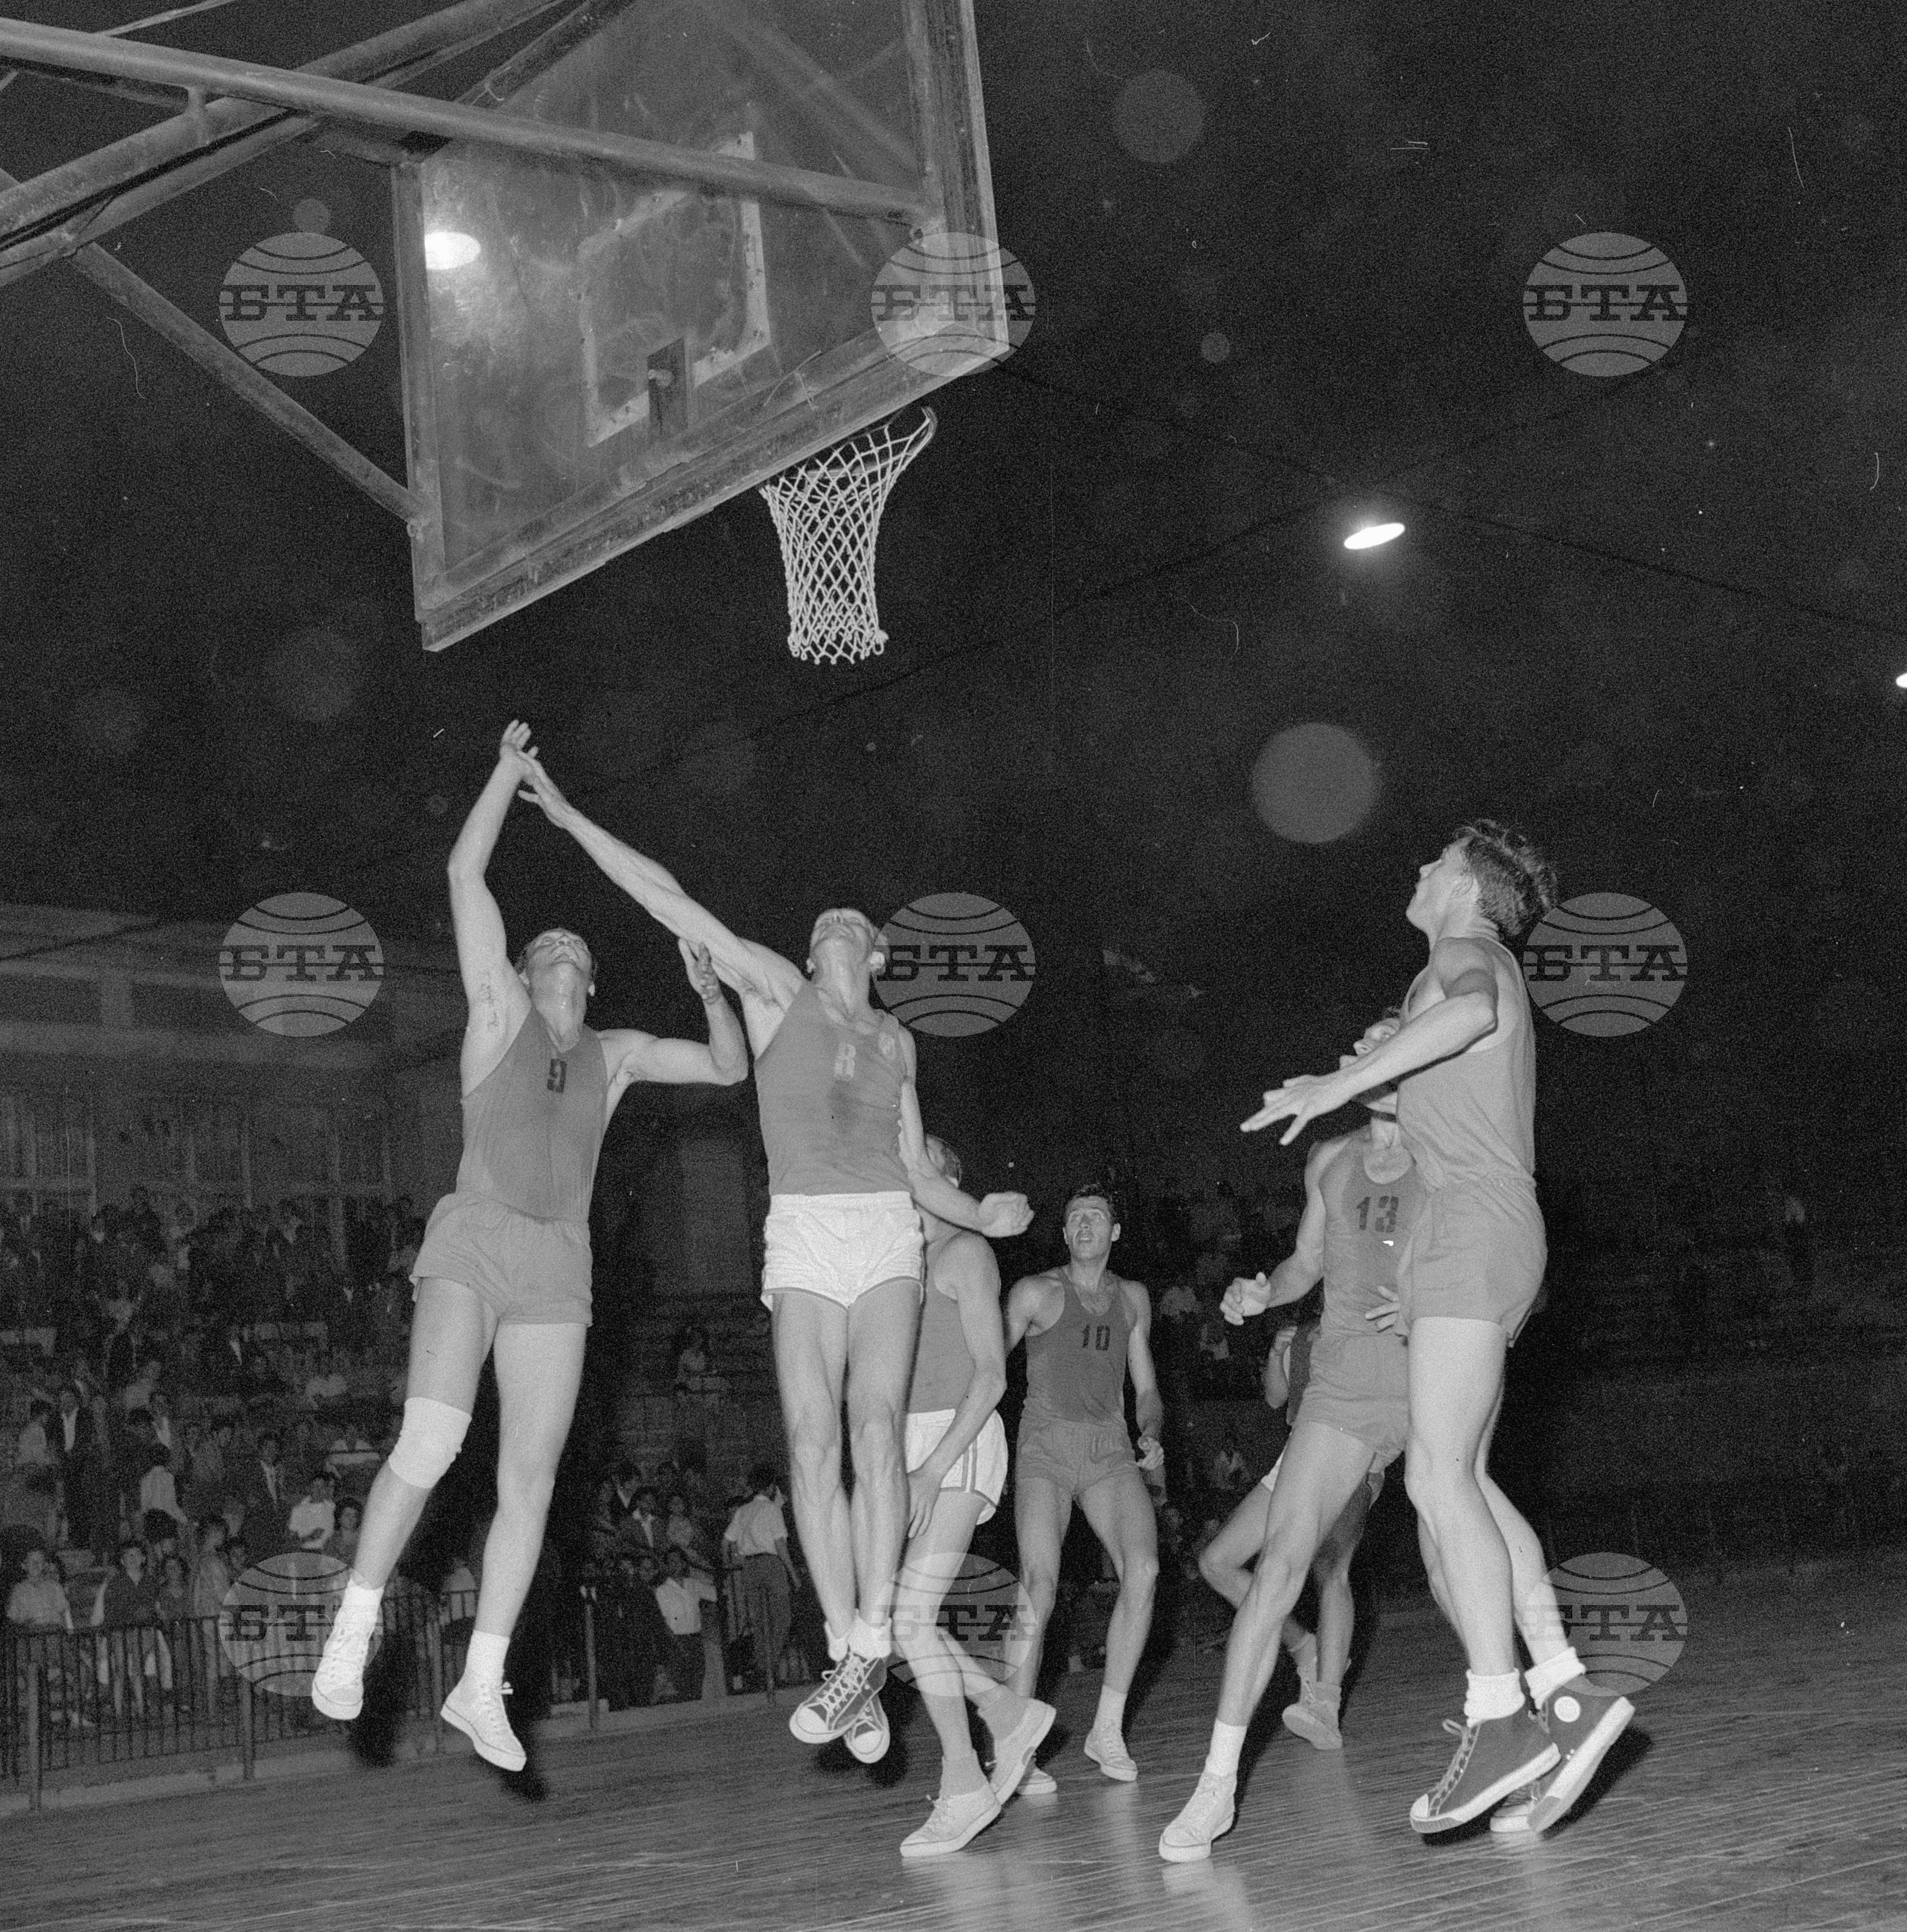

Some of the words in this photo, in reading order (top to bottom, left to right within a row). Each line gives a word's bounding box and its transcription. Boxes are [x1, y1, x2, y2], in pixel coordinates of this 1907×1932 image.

[547, 1058, 567, 1093] 9
[1356, 1196, 1399, 1232] 13
[1082, 1325, 1110, 1350] 10
